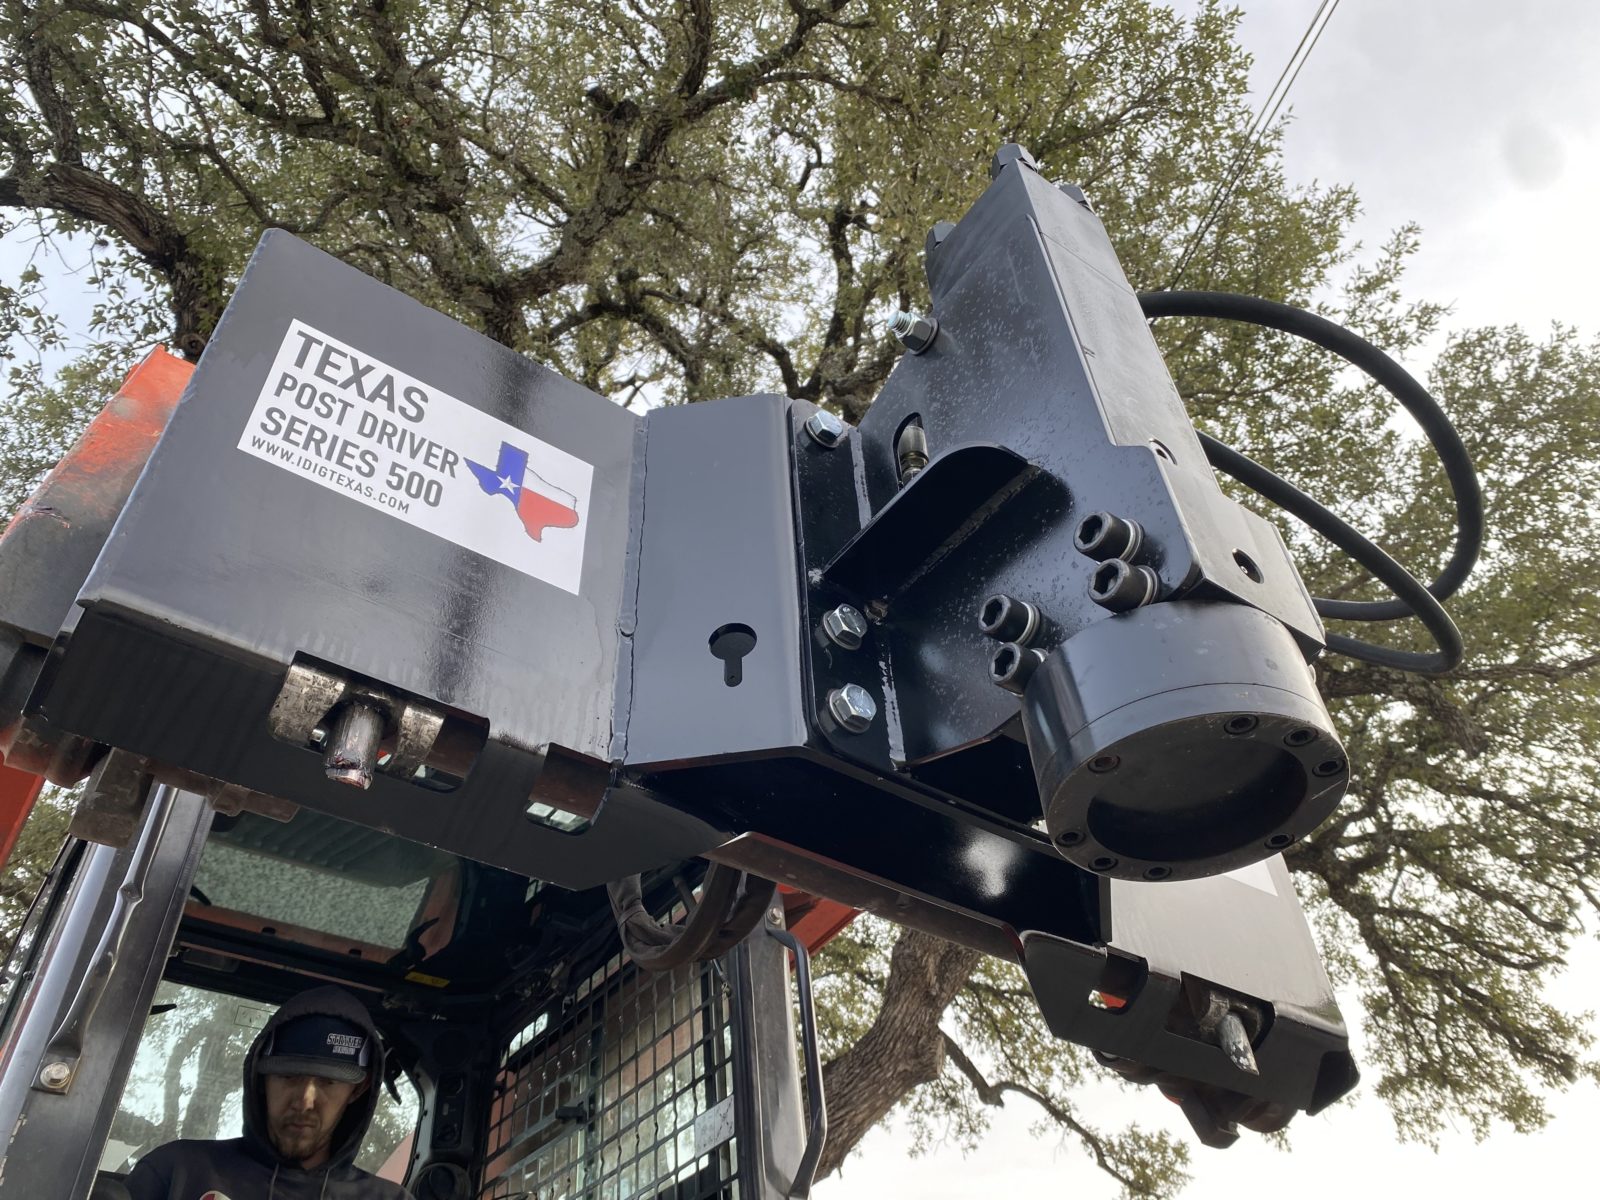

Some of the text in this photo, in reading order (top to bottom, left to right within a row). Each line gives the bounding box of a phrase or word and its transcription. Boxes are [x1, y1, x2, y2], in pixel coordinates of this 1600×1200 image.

[274, 372, 459, 478] POST DRIVER
[294, 330, 429, 423] TEXAS
[251, 435, 410, 514] WWW.IDIGTEXAS.COM
[260, 407, 443, 508] SERIES 500
